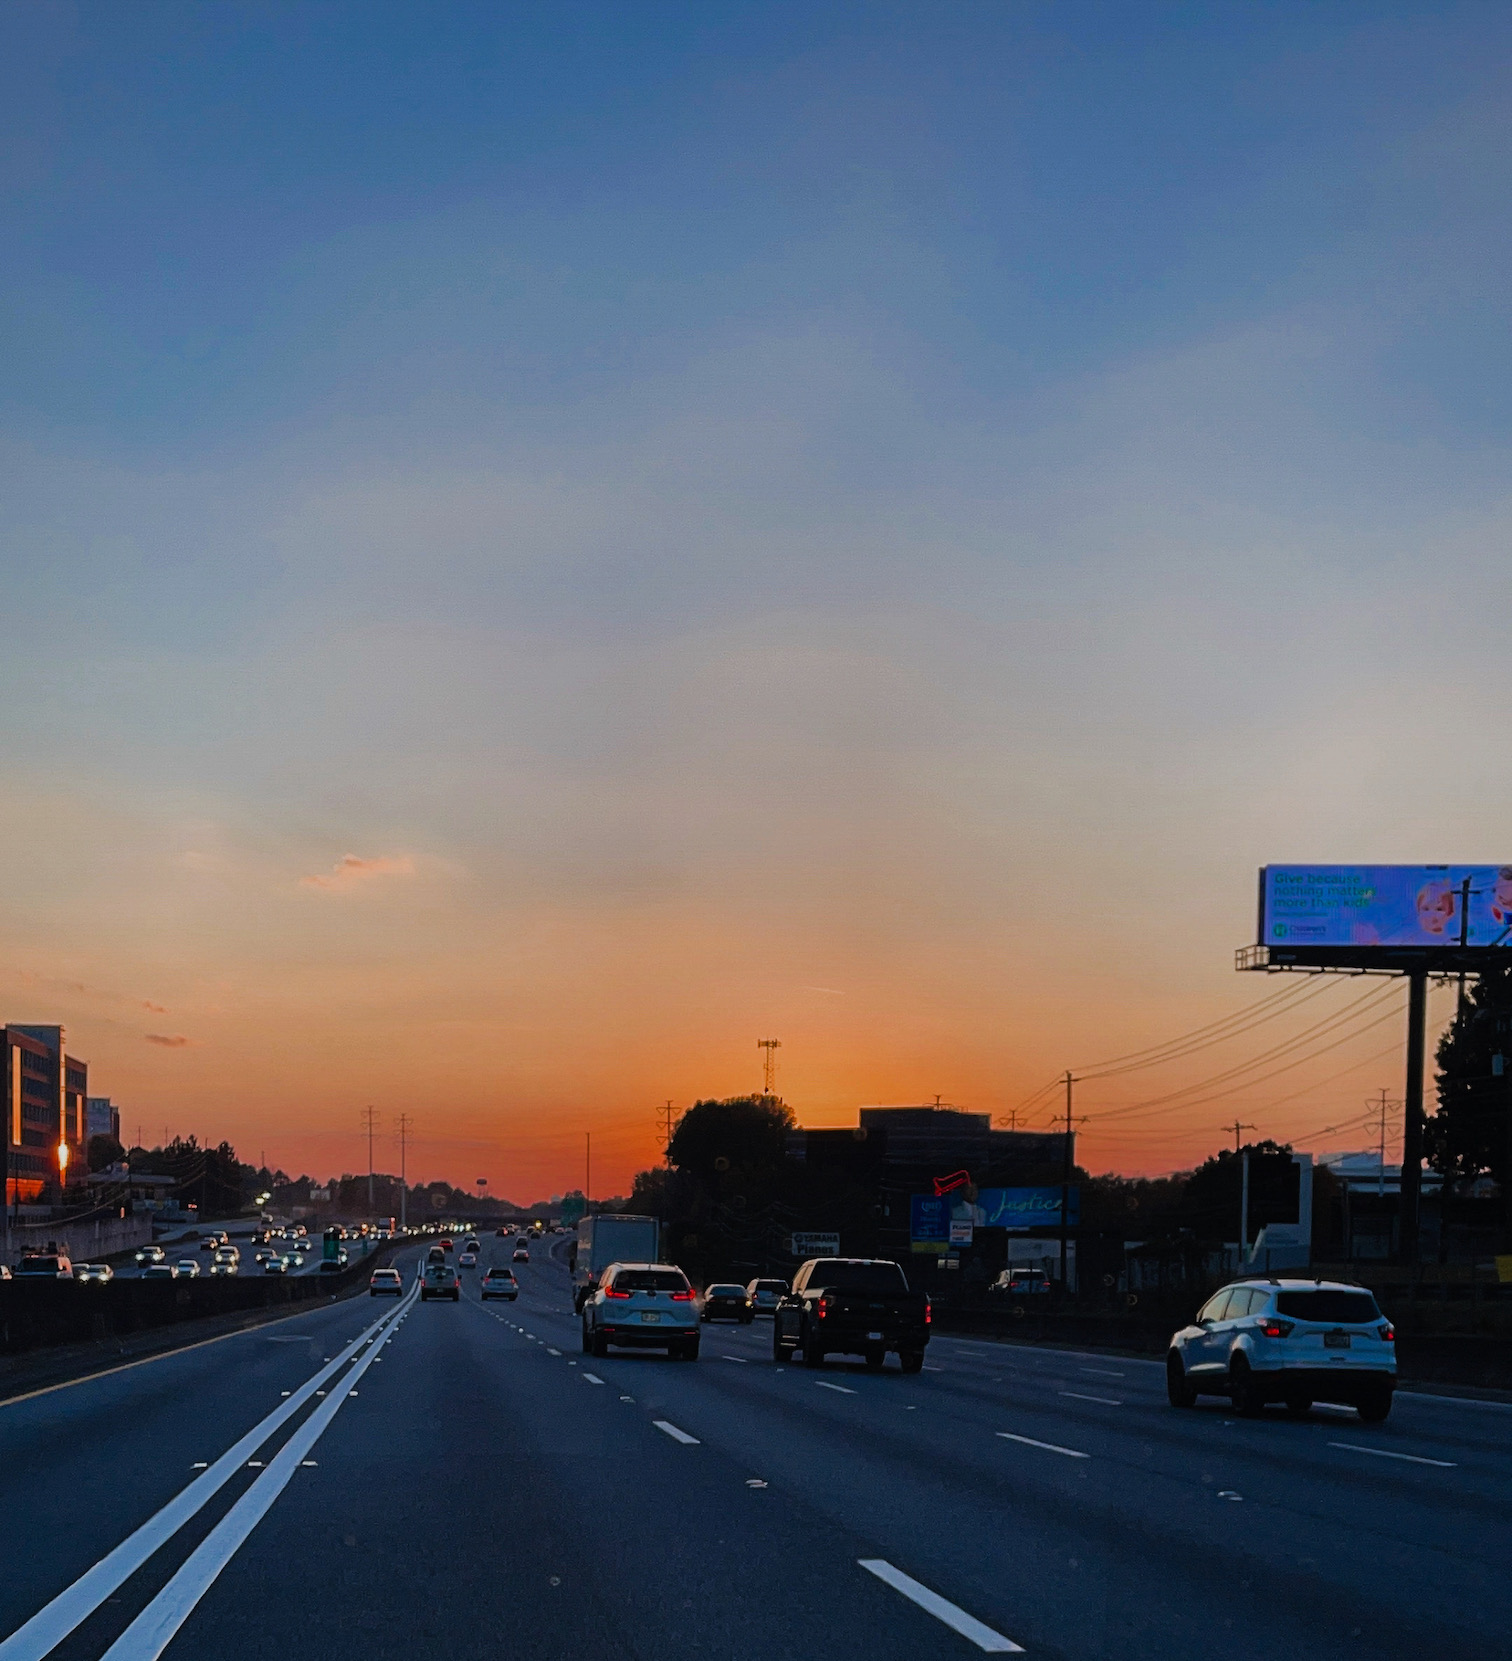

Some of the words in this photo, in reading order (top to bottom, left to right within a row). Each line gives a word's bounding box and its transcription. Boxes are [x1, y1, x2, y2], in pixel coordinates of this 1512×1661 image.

[1275, 873, 1303, 883] Give
[1307, 873, 1360, 884] because
[1275, 886, 1323, 897] nothing
[1327, 886, 1377, 896] matters
[1274, 899, 1306, 907] more
[1311, 897, 1339, 907] than
[1343, 897, 1370, 907] kids
[804, 1234, 838, 1242] YAMAHA
[797, 1243, 834, 1254] Pianos
